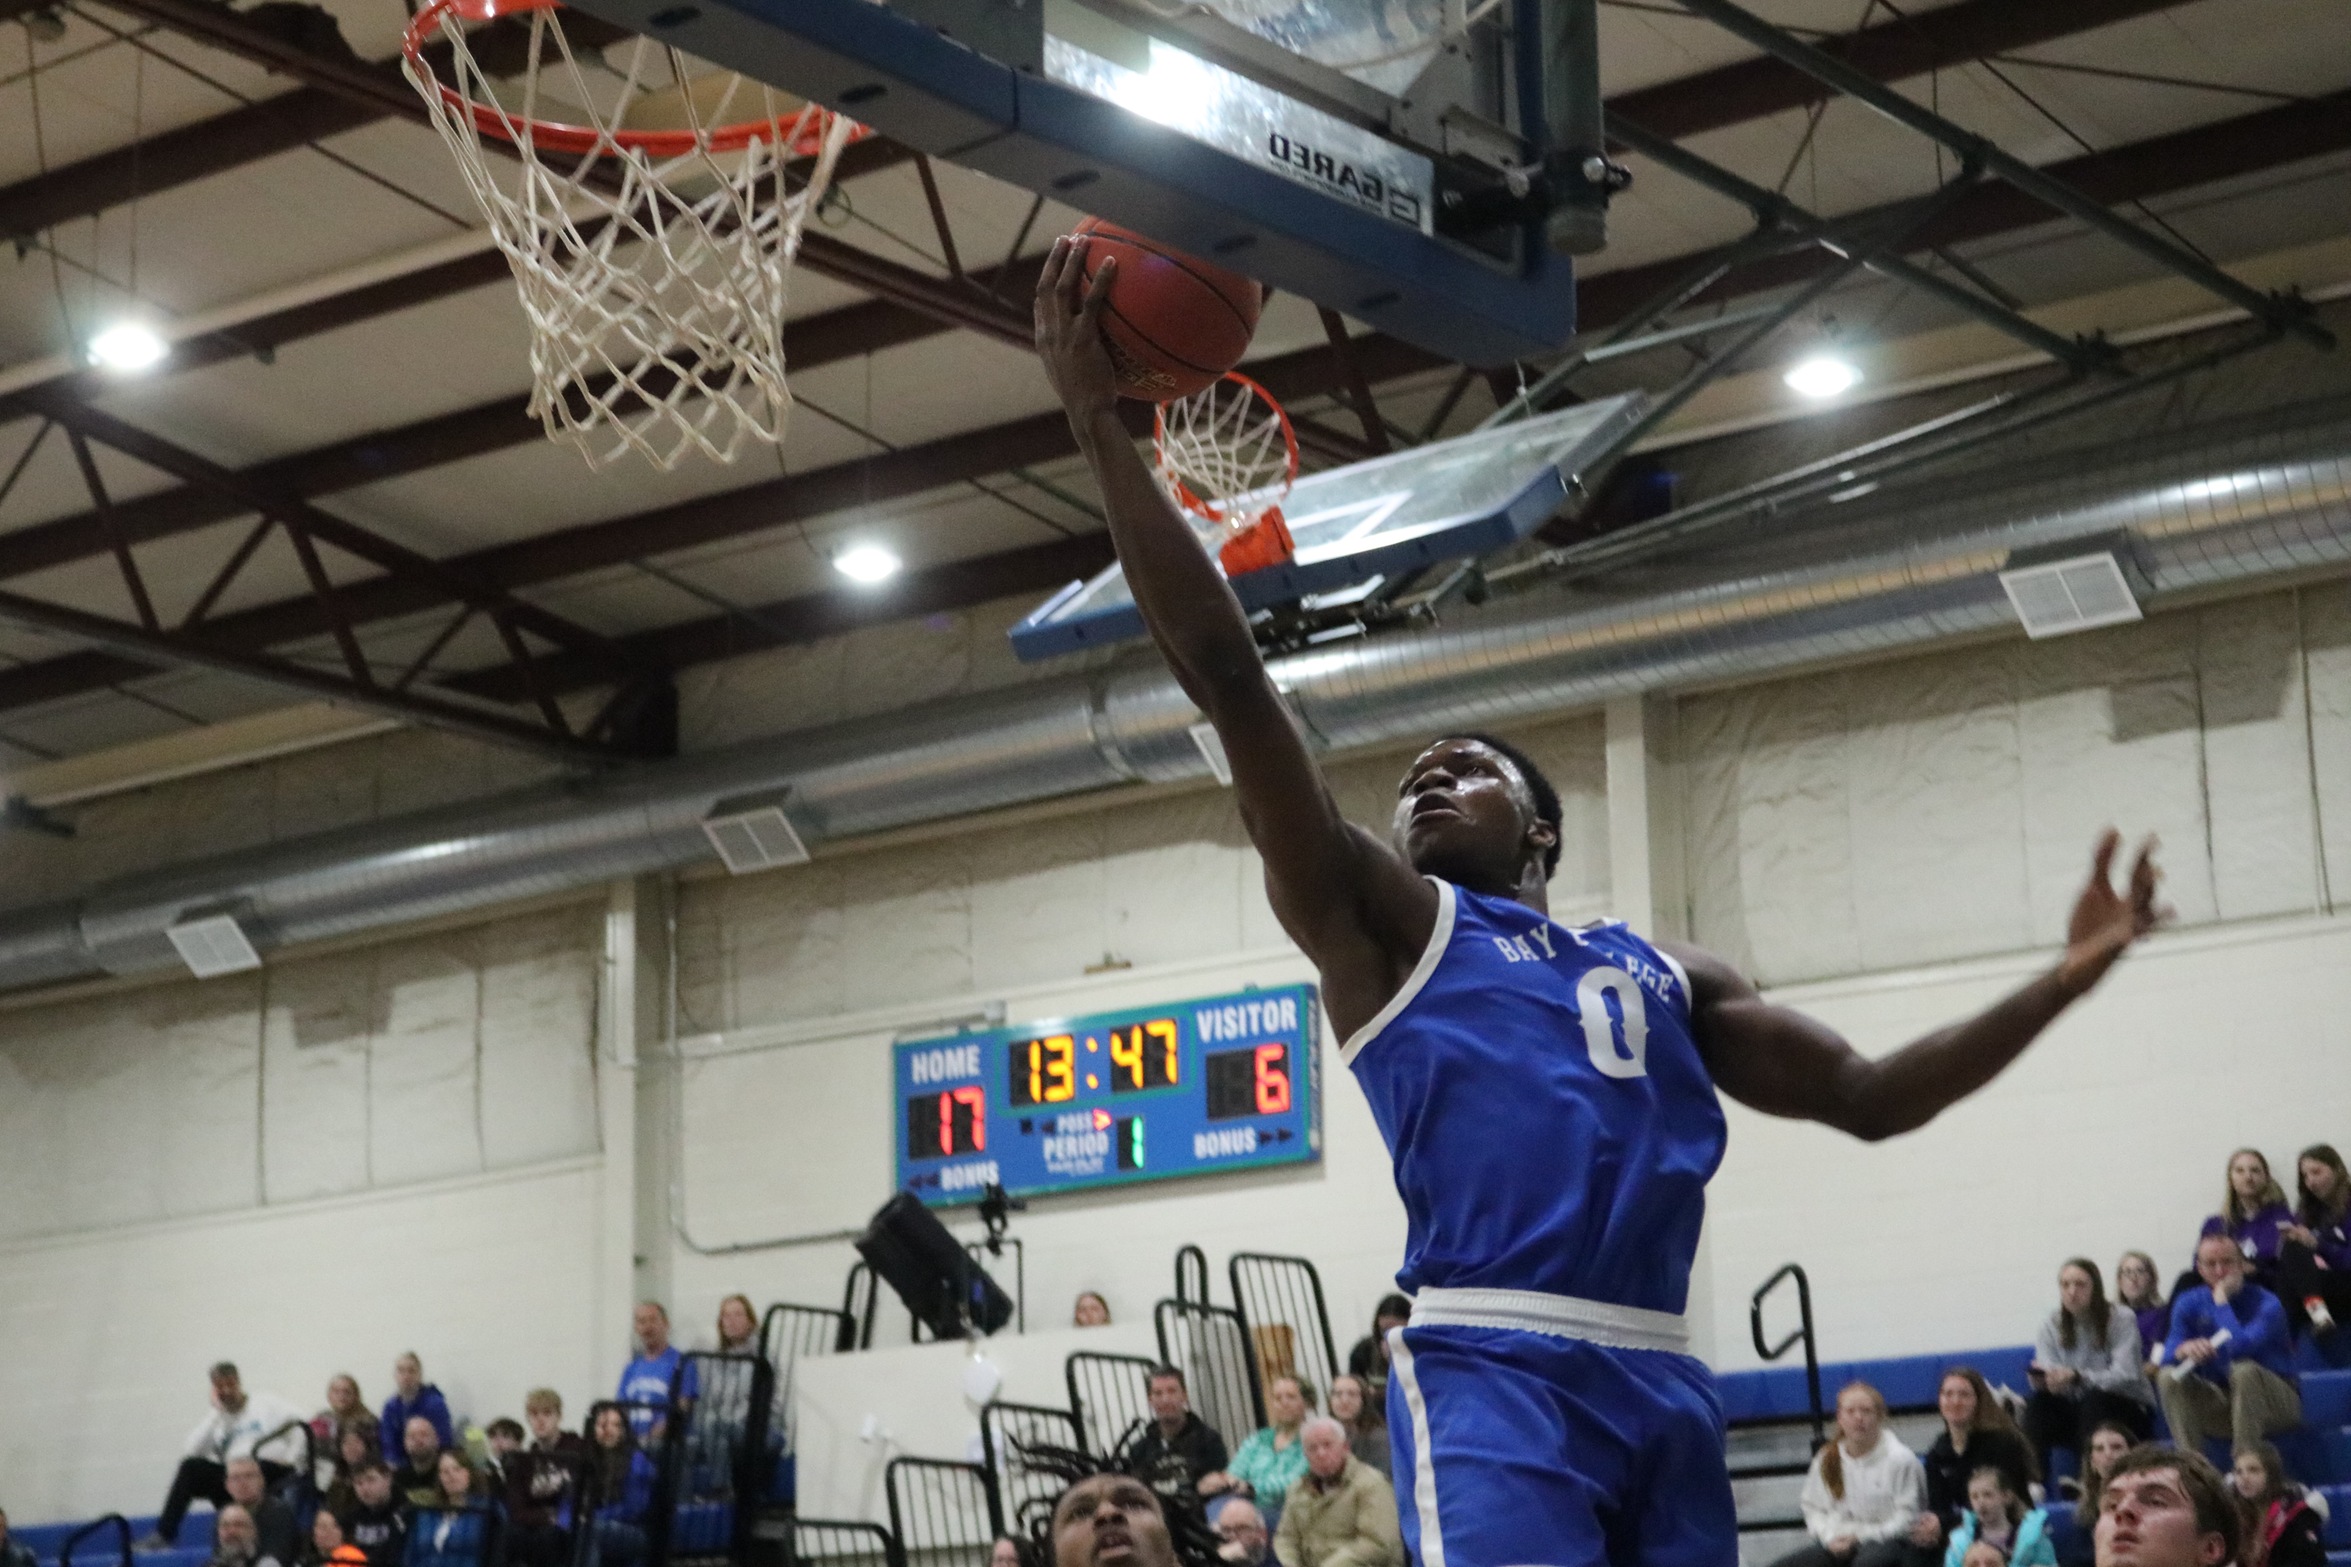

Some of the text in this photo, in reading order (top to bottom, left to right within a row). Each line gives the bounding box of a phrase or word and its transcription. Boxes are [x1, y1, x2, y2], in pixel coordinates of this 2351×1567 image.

[1492, 923, 1557, 963] BAY
[1196, 999, 1297, 1043] VISITOR
[1577, 965, 1650, 1079] 0
[911, 1044, 980, 1084] HOME
[1028, 1018, 1178, 1104] 13:47
[1253, 1043, 1291, 1115] 6
[938, 1085, 986, 1156] 17
[1131, 1115, 1145, 1169] 1
[1042, 1130, 1109, 1161] PERIOD
[1193, 1128, 1257, 1160] BONUS
[940, 1160, 999, 1192] BONUS
